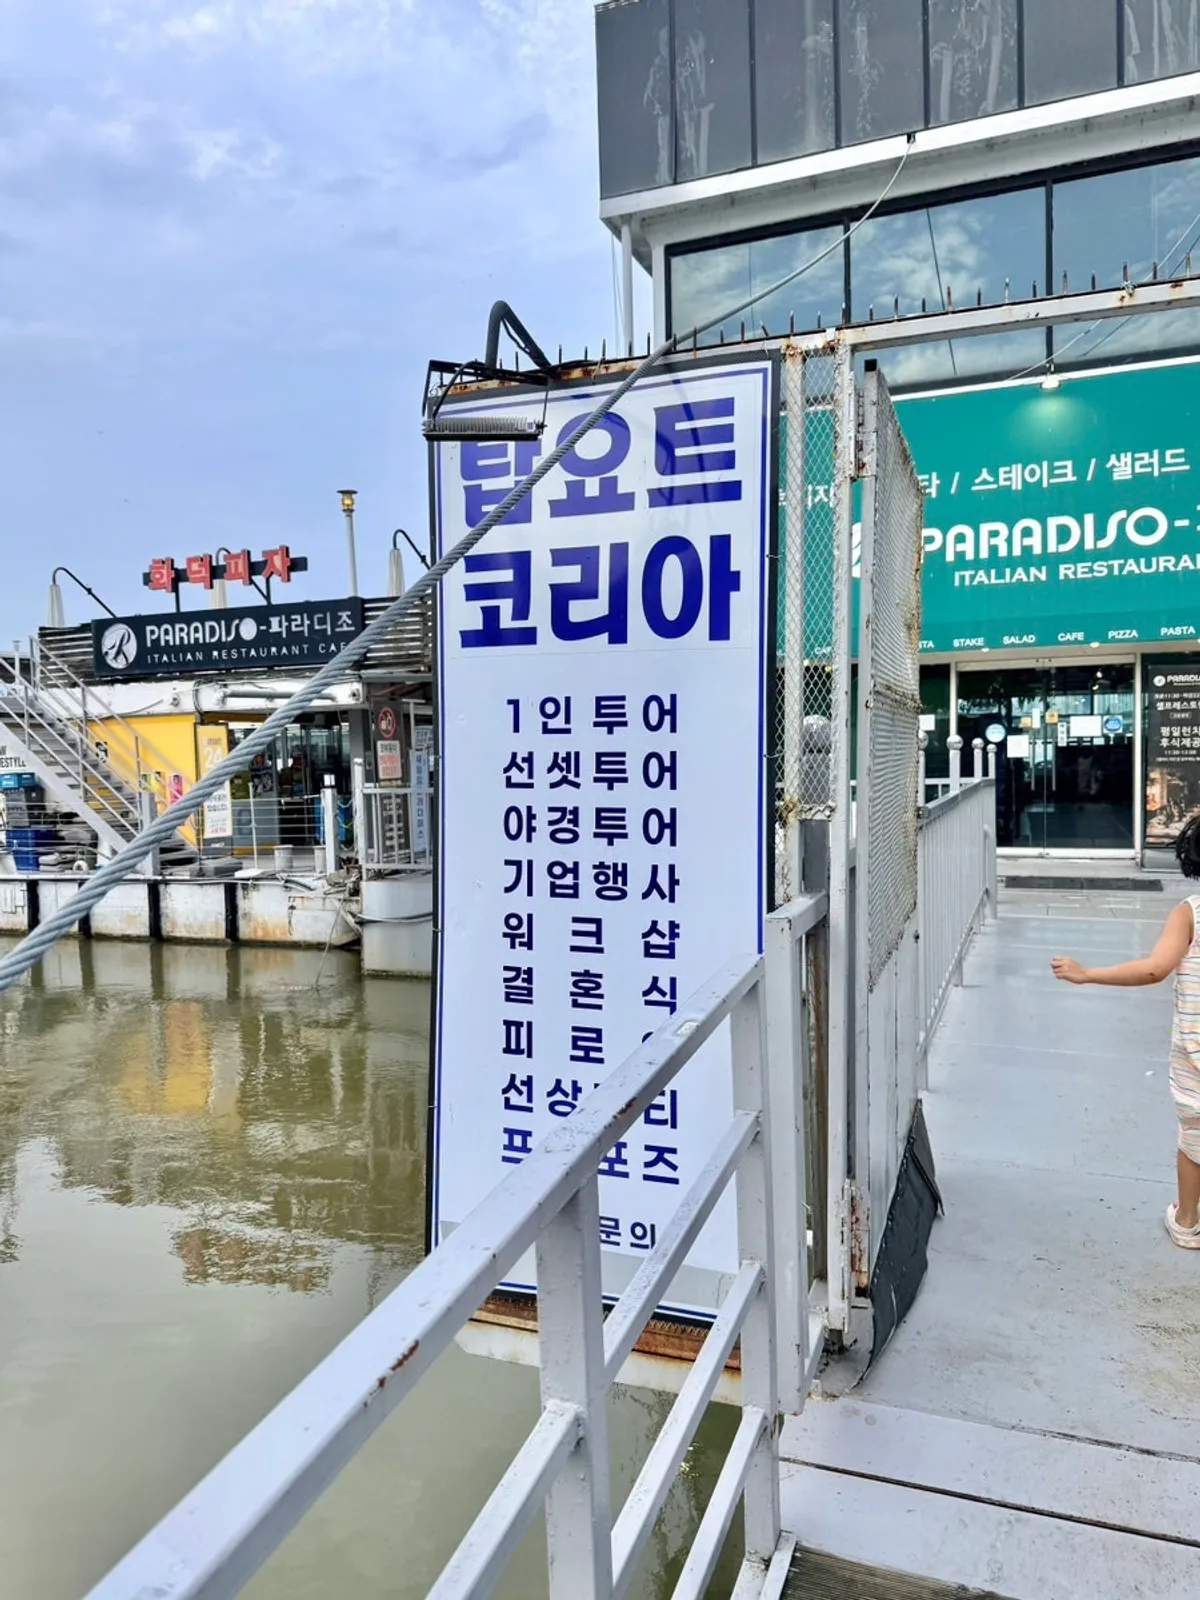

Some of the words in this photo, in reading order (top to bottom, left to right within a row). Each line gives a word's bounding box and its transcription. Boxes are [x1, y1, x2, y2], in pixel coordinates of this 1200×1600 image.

[459, 396, 743, 528] 탑요트
[971, 459, 1077, 491] 스테이크
[1105, 448, 1191, 481] 샐러드
[921, 506, 1200, 564] PARADISO-
[149, 545, 291, 593] 화덕피자
[459, 534, 741, 649] 코리아
[953, 565, 1047, 587] ITALIAN
[147, 651, 204, 664] ITALIAN
[212, 643, 310, 660] RESTAURANT
[953, 636, 984, 648] STAKE
[1002, 634, 1036, 645] SALAD
[1057, 631, 1085, 642] CAFE
[1108, 629, 1139, 640] PIZZA
[1160, 625, 1196, 636] PASTA
[502, 750, 678, 791] 선셋투어
[503, 805, 678, 848] 야경투어
[503, 859, 681, 904] 기업행사
[502, 912, 681, 960] 워크샵
[502, 965, 678, 1016] 결혼식
[501, 1073, 678, 1129] 선상티
[501, 1127, 680, 1185] 프포즈
